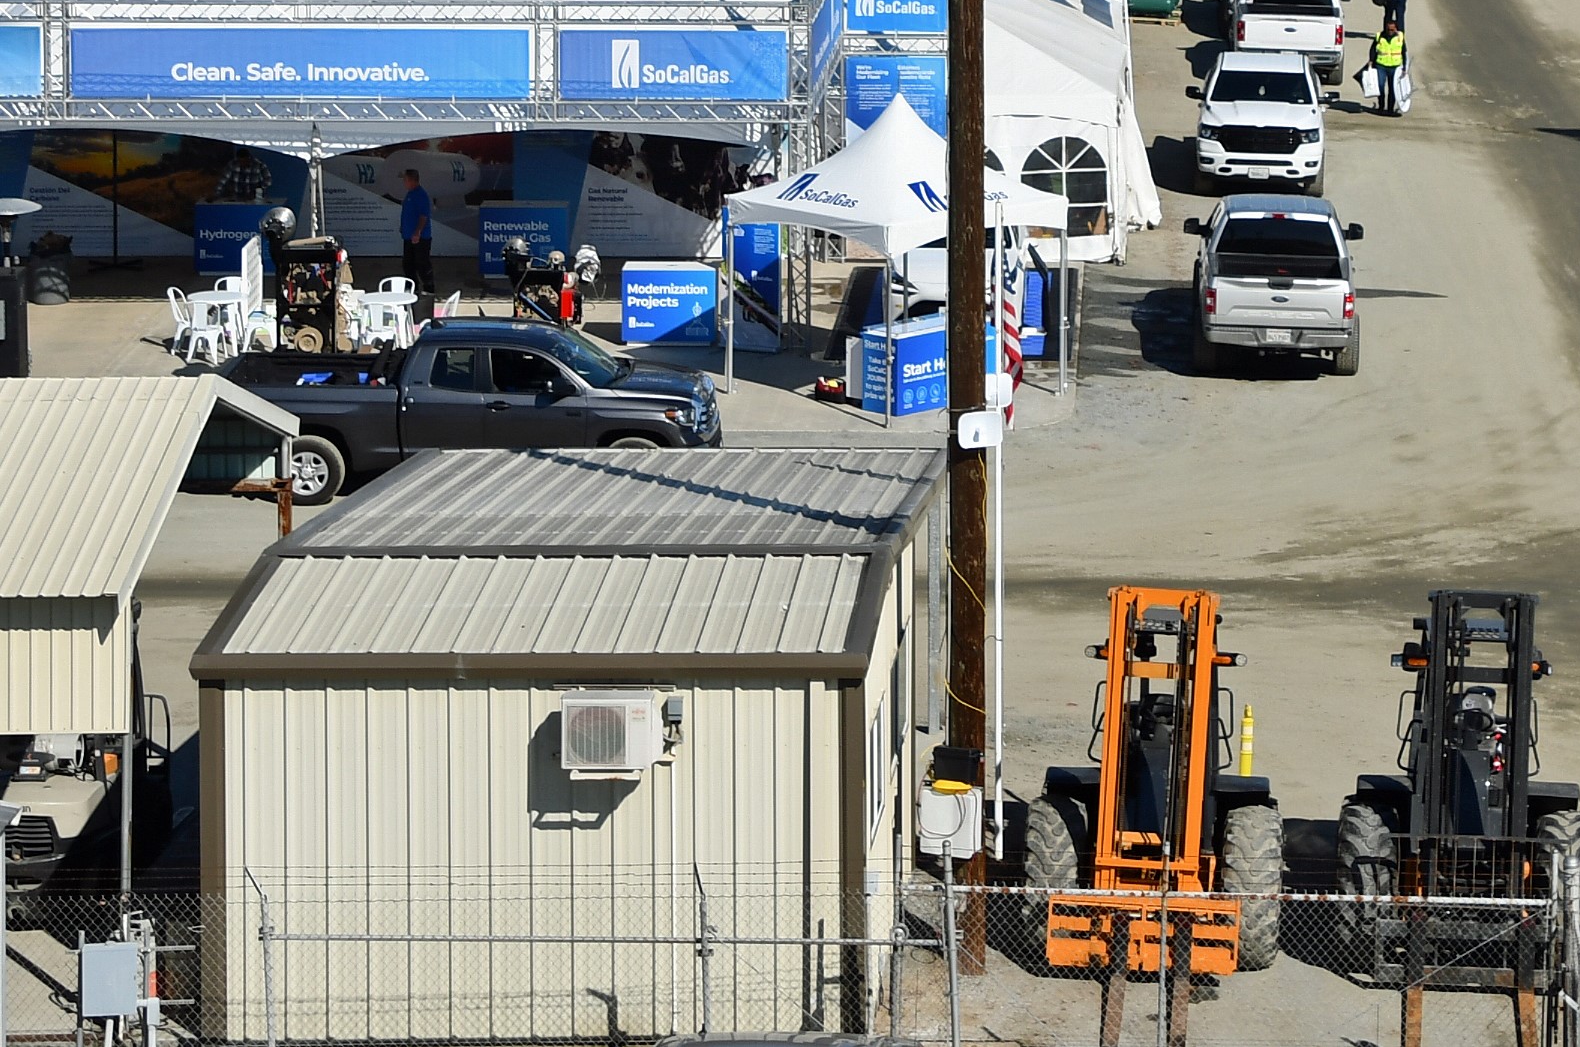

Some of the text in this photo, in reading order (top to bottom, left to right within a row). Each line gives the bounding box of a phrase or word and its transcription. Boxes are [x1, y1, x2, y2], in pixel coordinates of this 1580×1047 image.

[877, 0, 936, 15] SoCalGas
[171, 62, 430, 82] Clean. Safe. Innovative.
[642, 64, 730, 84] SoCalGas
[355, 163, 375, 184] H2
[450, 161, 466, 182] H2
[800, 188, 859, 210] SoCalGas
[484, 221, 549, 231] Renewable
[200, 229, 260, 241] Hydrogen
[529, 233, 552, 242] Gas
[627, 283, 708, 295] Modernization
[627, 296, 680, 310] Projects
[903, 360, 932, 378] Start
